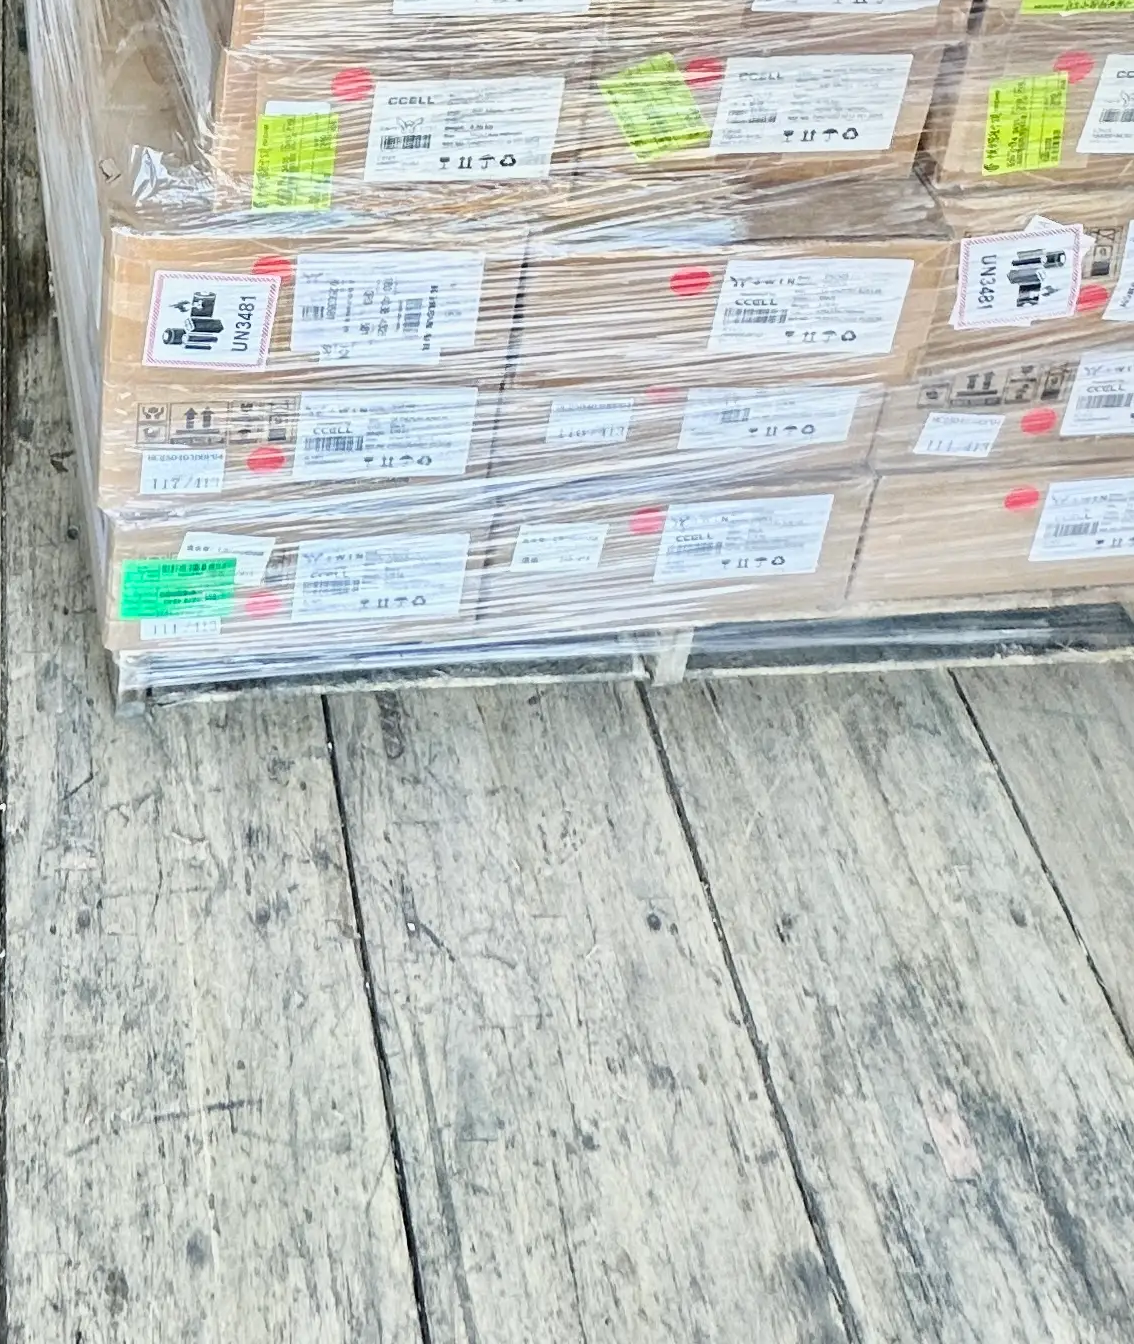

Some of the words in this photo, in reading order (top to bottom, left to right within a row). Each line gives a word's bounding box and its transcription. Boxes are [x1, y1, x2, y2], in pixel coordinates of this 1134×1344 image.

[388, 96, 435, 105] CCELL
[976, 254, 998, 309] UN3481
[735, 298, 779, 306] CCELL
[230, 295, 258, 353] UN3481
